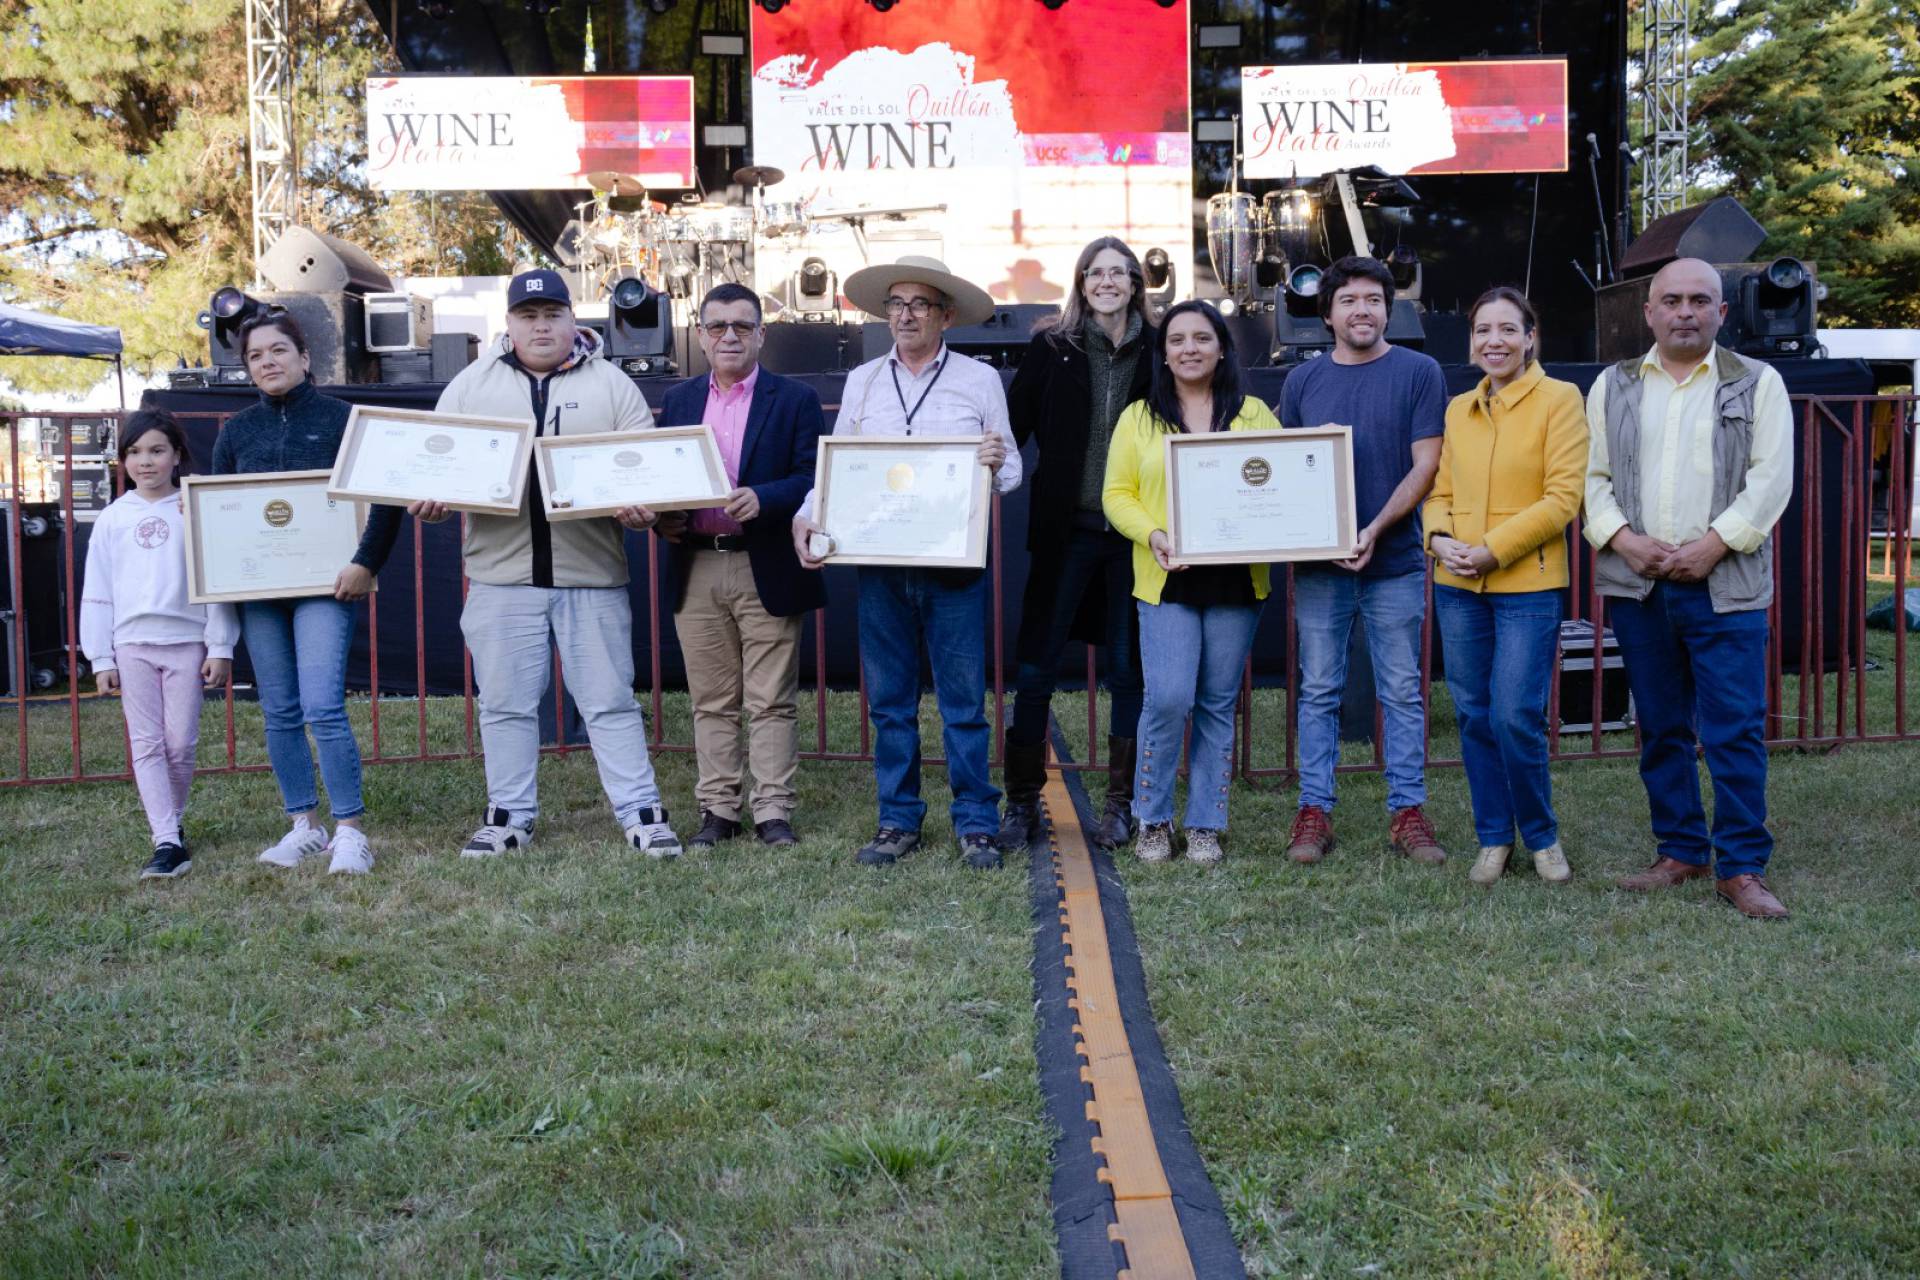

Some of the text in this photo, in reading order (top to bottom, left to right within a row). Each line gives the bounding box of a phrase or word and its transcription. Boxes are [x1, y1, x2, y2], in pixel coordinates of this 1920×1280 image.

[808, 105, 844, 115] VALLE
[850, 104, 873, 115] DEL
[878, 103, 901, 115] SOL
[1257, 98, 1391, 135] WINE
[382, 113, 514, 147] WINE
[804, 120, 957, 171] WINE
